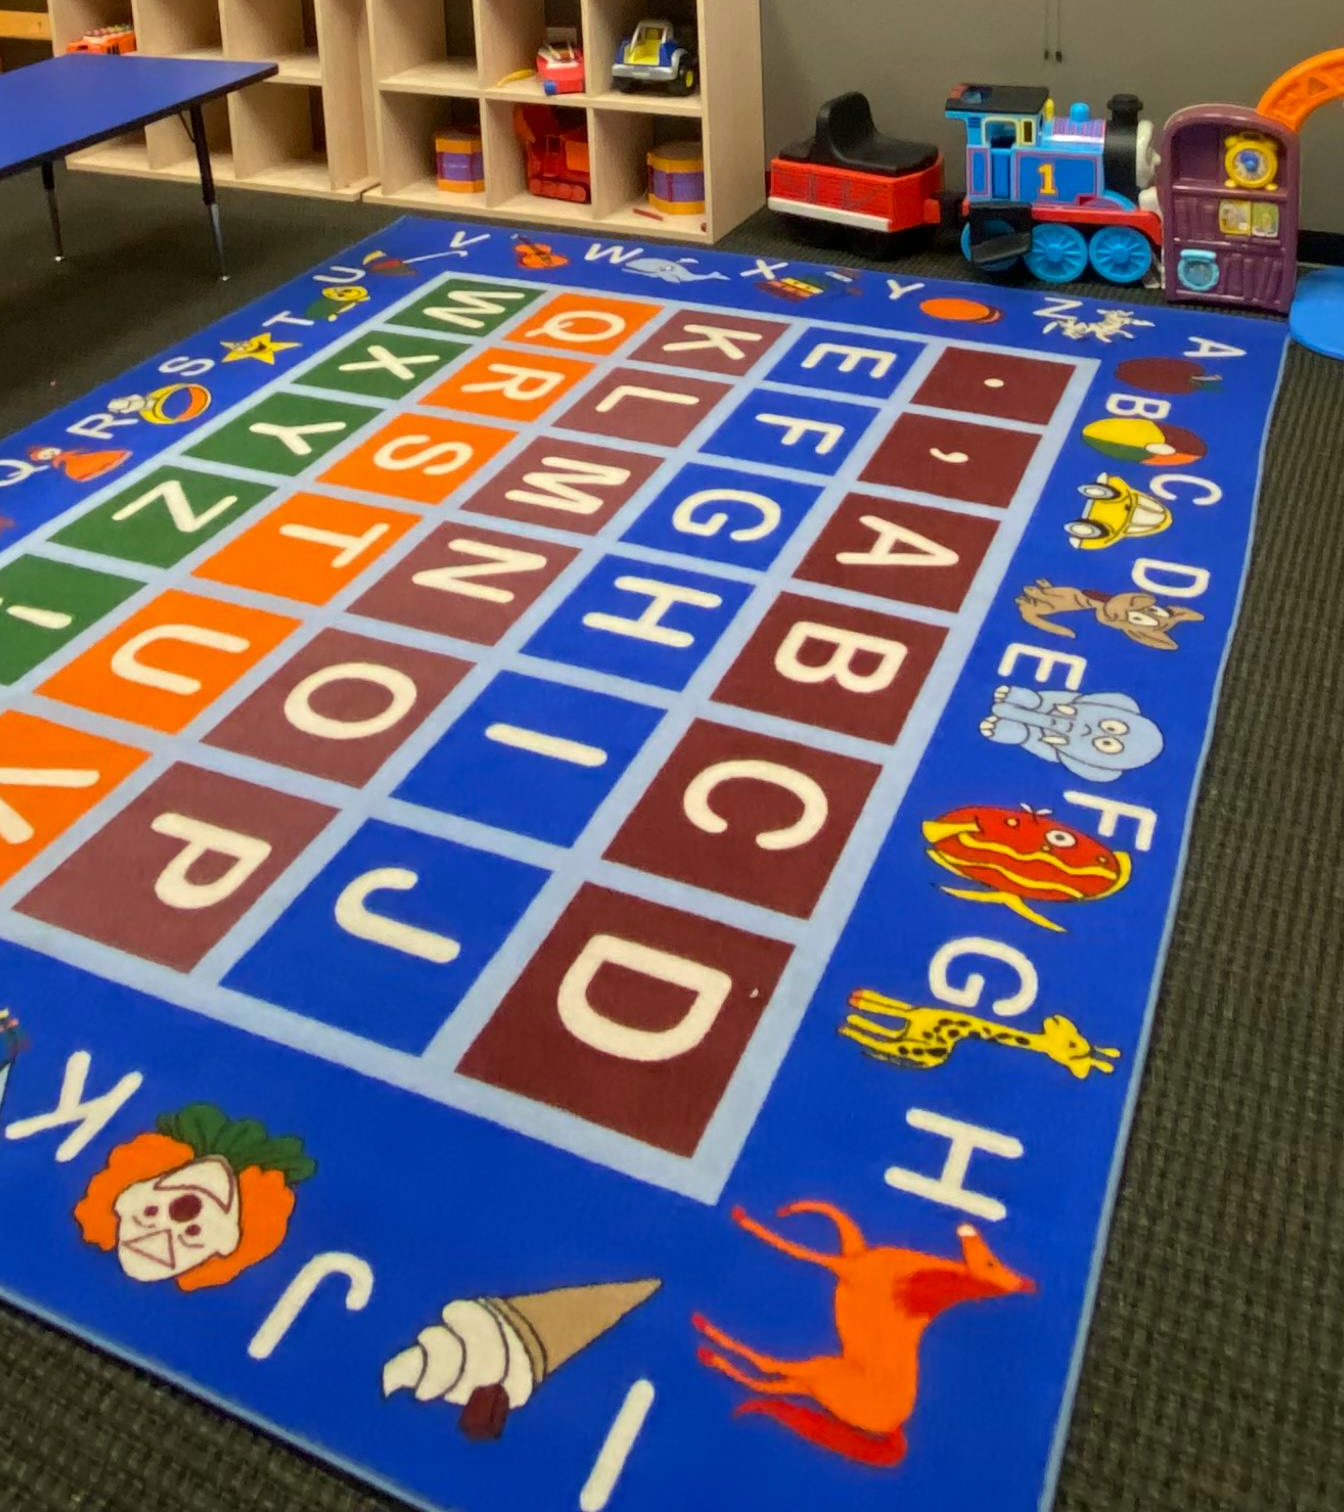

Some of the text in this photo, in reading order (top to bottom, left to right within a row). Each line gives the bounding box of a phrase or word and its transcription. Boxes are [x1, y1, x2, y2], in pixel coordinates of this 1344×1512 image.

[1039, 163, 1056, 194] 1
[423, 290, 525, 328] W
[449, 230, 1083, 321] V W X Y Z
[66, 412, 139, 440] R
[158, 356, 216, 376] S
[262, 310, 315, 328] T
[313, 266, 367, 284] U
[526, 310, 625, 342] Q
[339, 345, 440, 380] X
[461, 363, 564, 401] R
[249, 421, 347, 456] Y
[373, 435, 473, 475] S
[111, 480, 238, 533] Z
[835, 515, 959, 566] A
[280, 523, 389, 568] T
[151, 324, 763, 909] K L M N O P
[111, 624, 249, 694] U
[336, 343, 896, 963] E F G H I J
[774, 621, 908, 693] B
[683, 759, 828, 850] C
[886, 336, 1247, 1220] A B C D E F G H
[557, 934, 732, 1061] D
[6, 1051, 143, 1161] K
[249, 1252, 374, 1359] J
[580, 1380, 654, 1512] I
